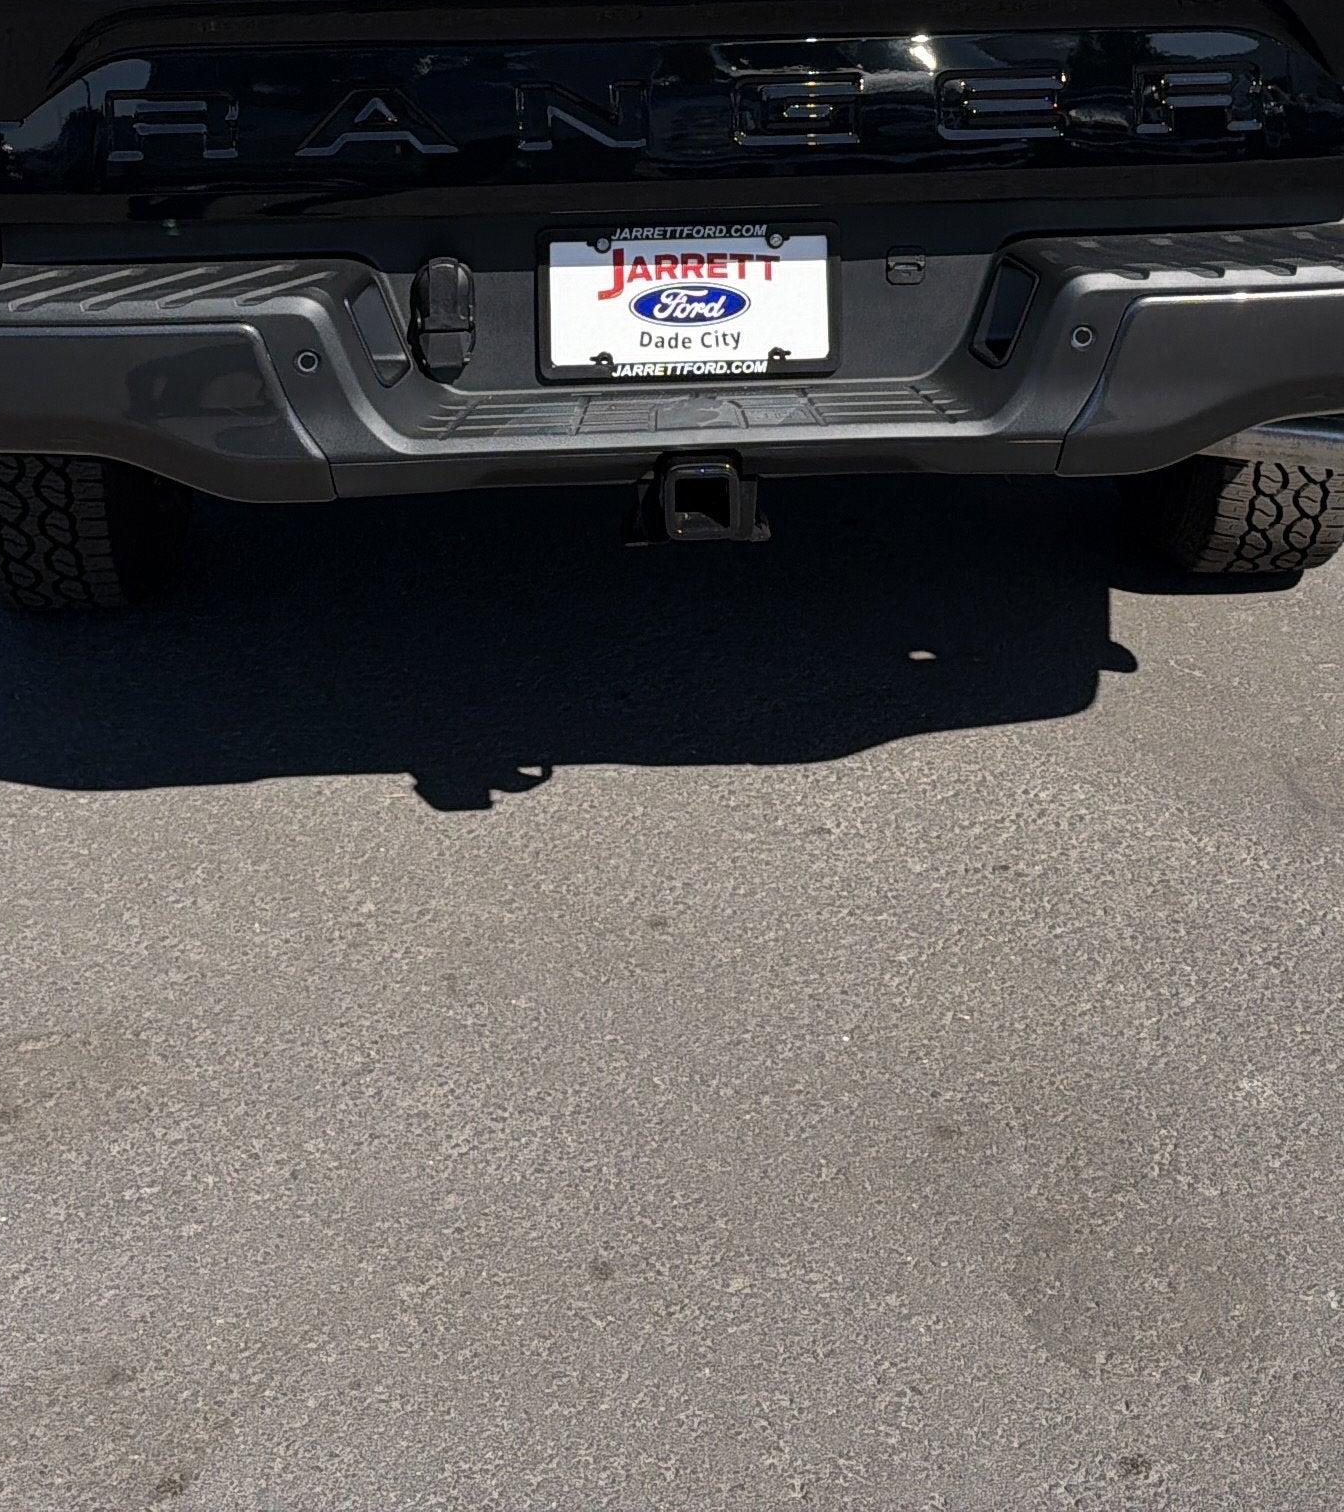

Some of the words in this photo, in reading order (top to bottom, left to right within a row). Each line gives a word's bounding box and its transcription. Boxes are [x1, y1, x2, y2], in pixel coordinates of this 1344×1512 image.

[103, 64, 1264, 163] RANGER
[611, 224, 768, 241] JARRETTFORD.COM
[597, 247, 781, 301] JARRETT
[652, 287, 727, 321] Ford
[640, 330, 693, 350] Dade
[700, 329, 742, 350] City
[611, 359, 768, 379] JARRETTFORD.COM
